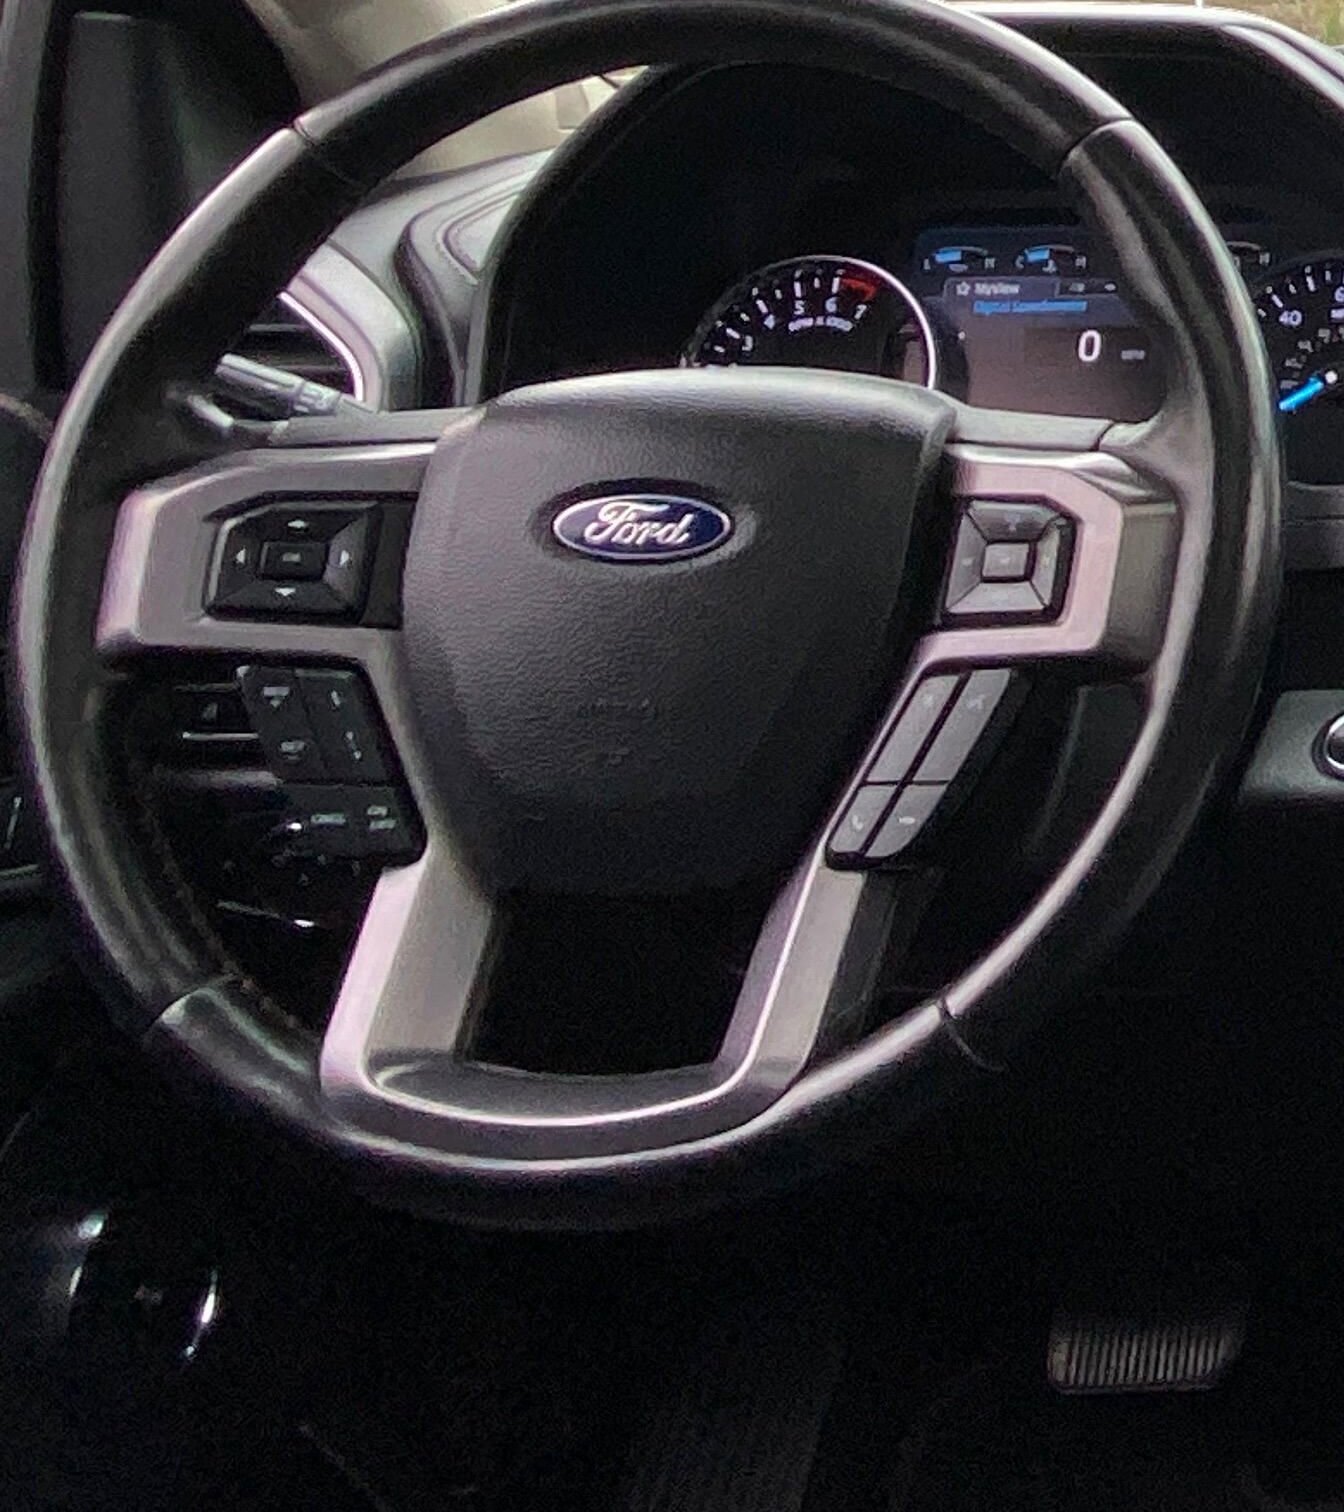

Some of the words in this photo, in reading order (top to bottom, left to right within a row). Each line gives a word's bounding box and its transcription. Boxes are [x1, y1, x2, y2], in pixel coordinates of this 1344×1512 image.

[825, 297, 838, 313] 6
[1279, 310, 1303, 326] 40
[1078, 329, 1102, 362] 0
[583, 500, 696, 545] Ford
